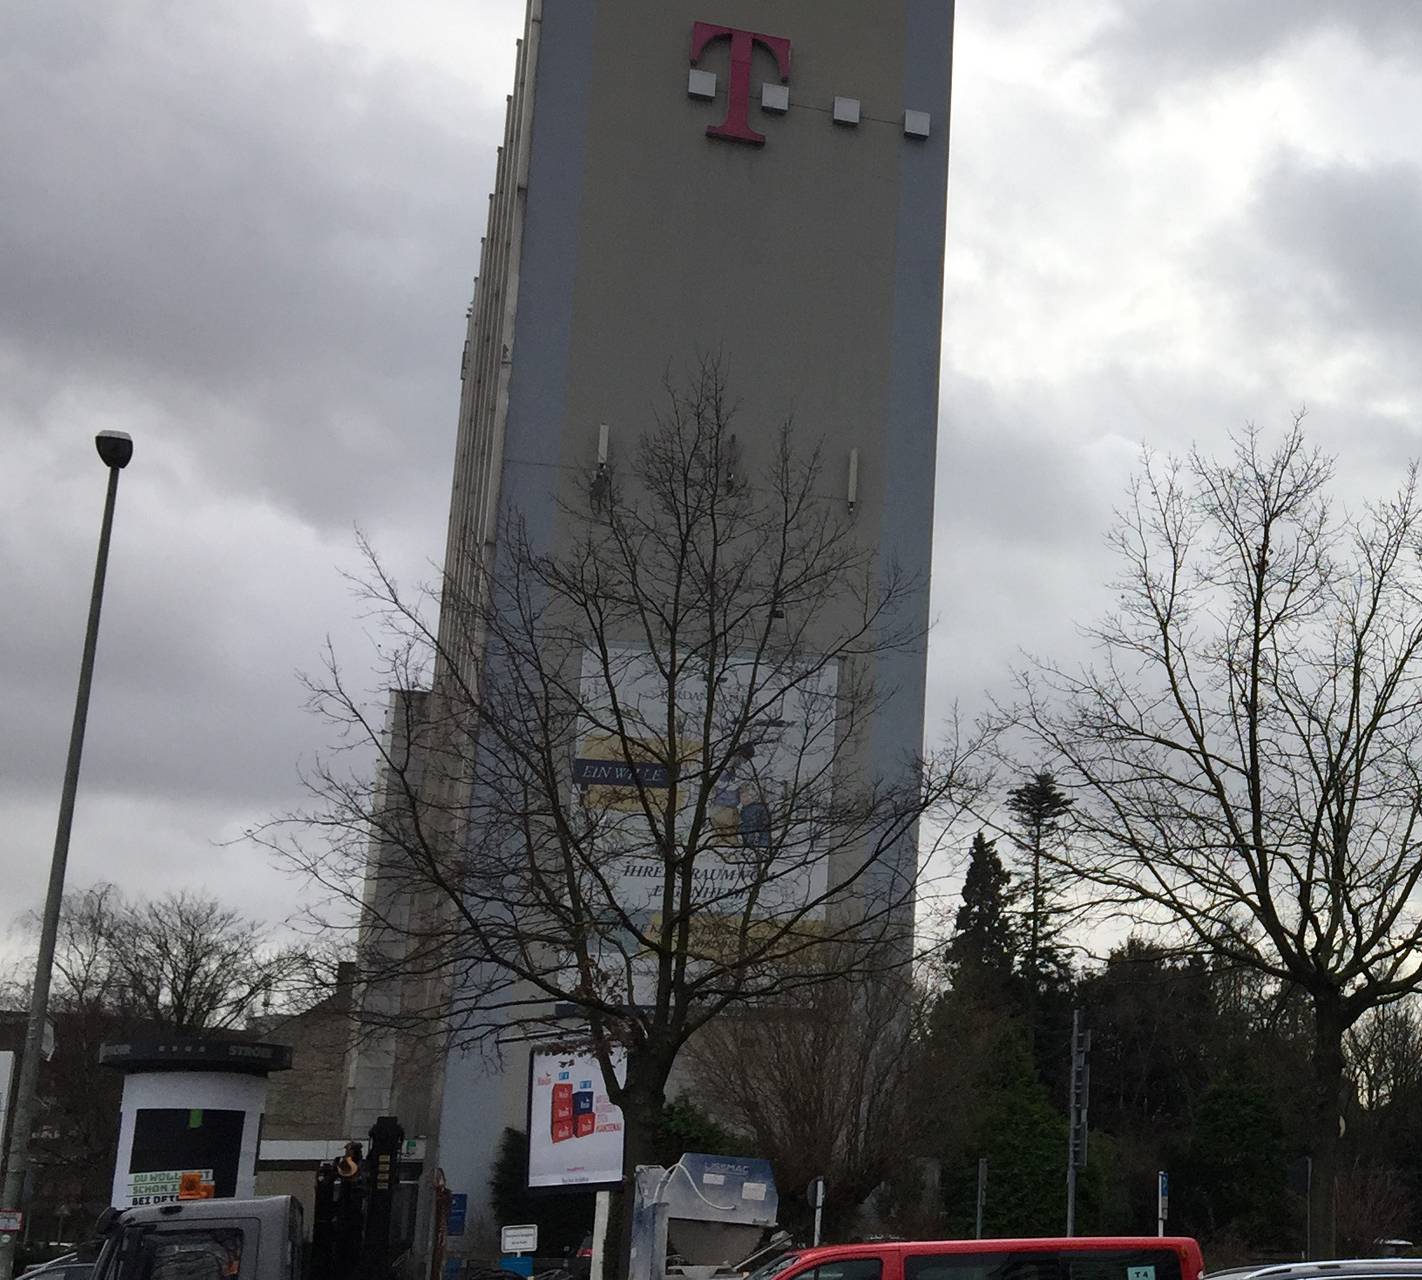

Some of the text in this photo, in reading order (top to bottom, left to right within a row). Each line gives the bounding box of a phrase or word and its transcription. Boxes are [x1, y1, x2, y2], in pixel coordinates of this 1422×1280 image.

[582, 765, 612, 779] EIN
[623, 864, 682, 879] IHRE
[686, 867, 739, 881] RAUM
[132, 1196, 151, 1206] BEI
